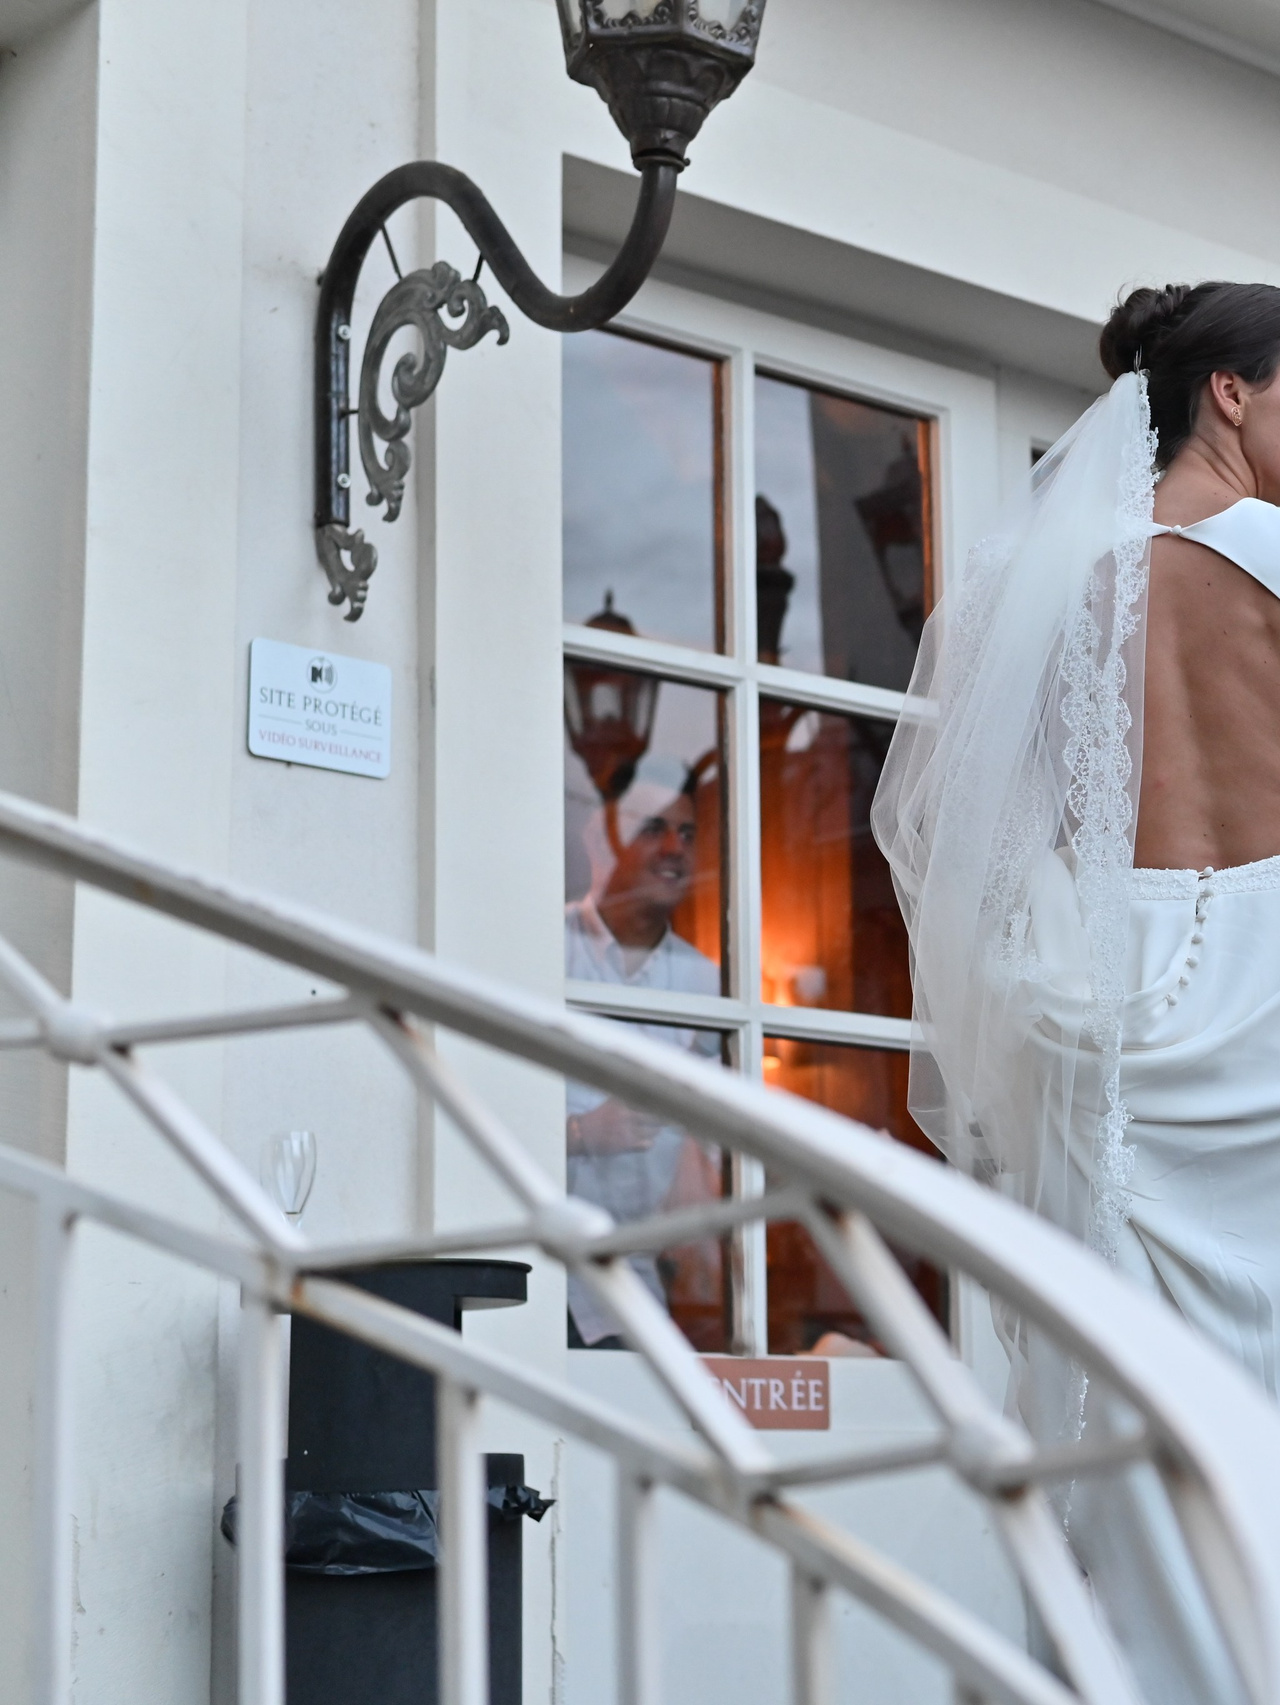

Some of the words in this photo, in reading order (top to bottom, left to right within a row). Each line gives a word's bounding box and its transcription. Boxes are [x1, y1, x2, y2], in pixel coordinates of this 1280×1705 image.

[260, 687, 296, 709] SITE
[303, 695, 383, 727] PROTÉGÉ
[305, 719, 338, 736] SOUS
[298, 738, 383, 763] SURVEILLANCE
